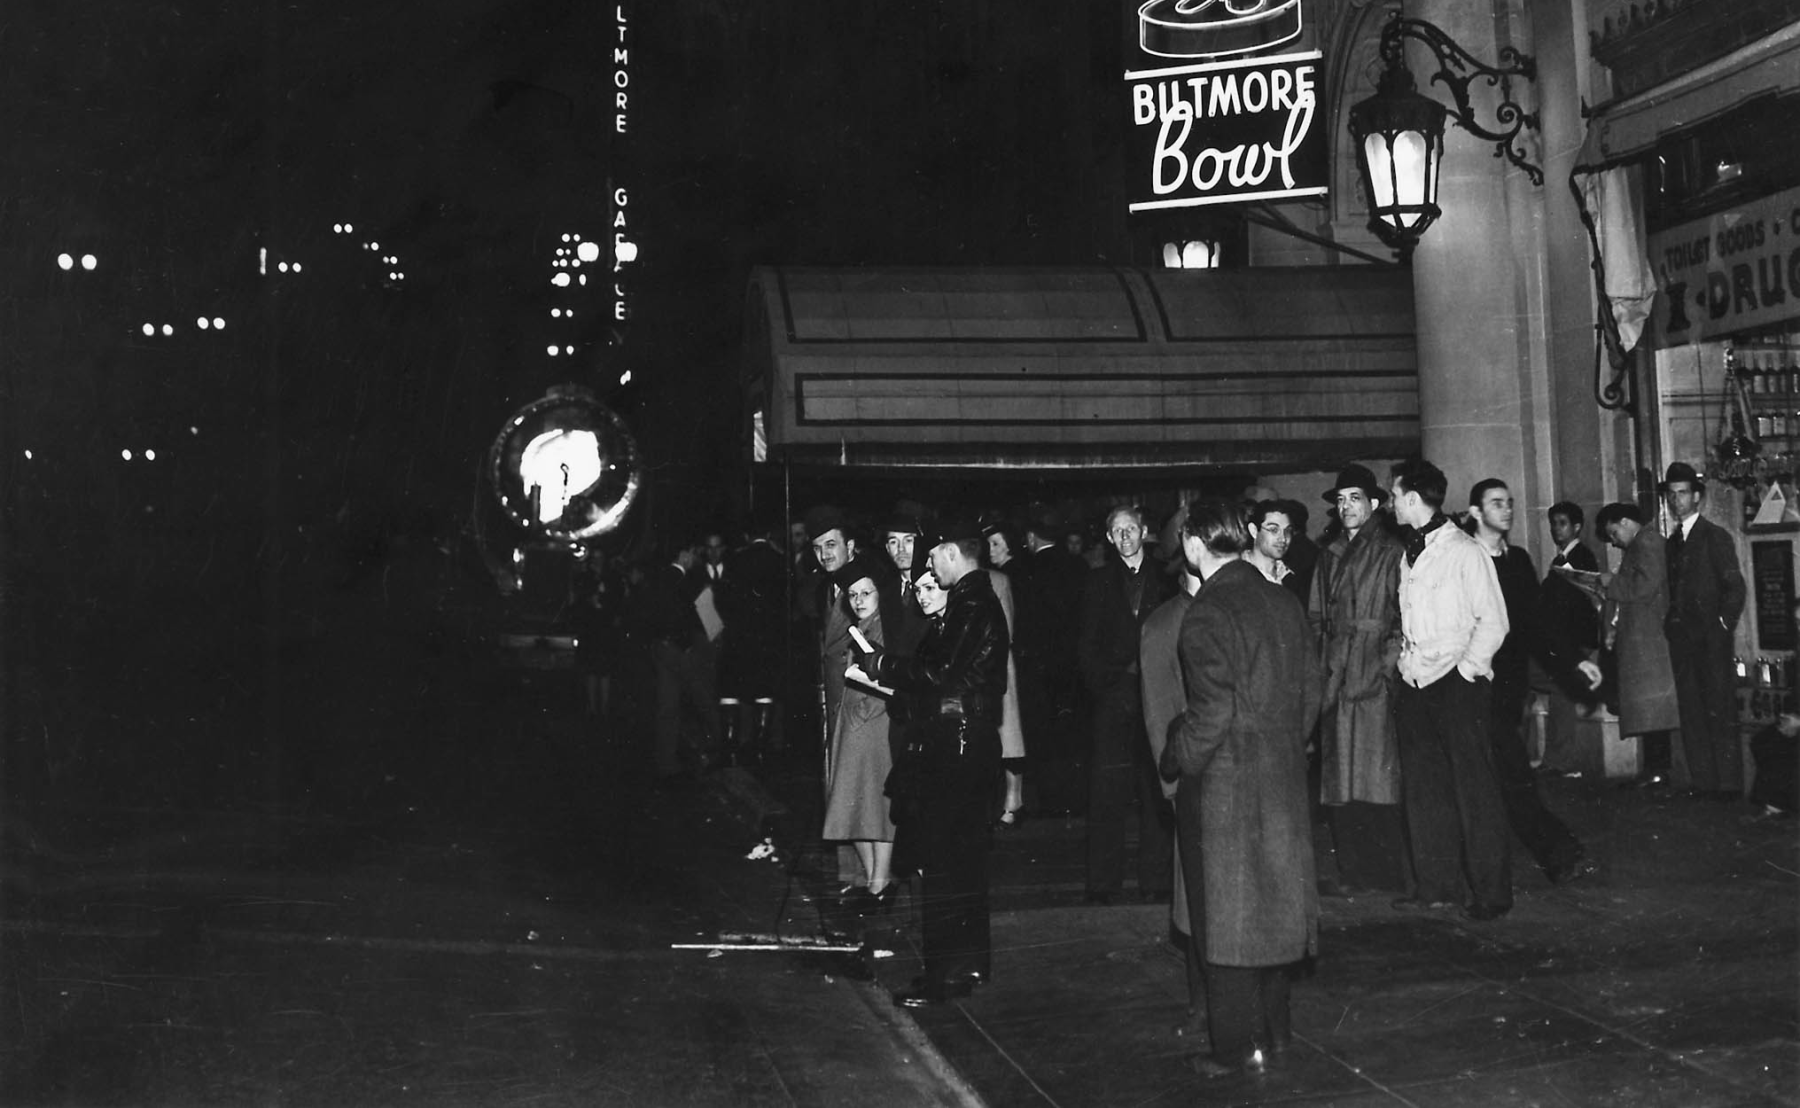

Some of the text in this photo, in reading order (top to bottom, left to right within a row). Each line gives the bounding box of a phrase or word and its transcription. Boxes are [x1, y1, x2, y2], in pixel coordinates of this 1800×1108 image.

[1133, 66, 1315, 126] BILTMORE
[1153, 89, 1316, 195] Bowl
[613, 187, 629, 320] GAE
[1665, 236, 1711, 272] TOILET
[1716, 220, 1766, 259] GOODS
